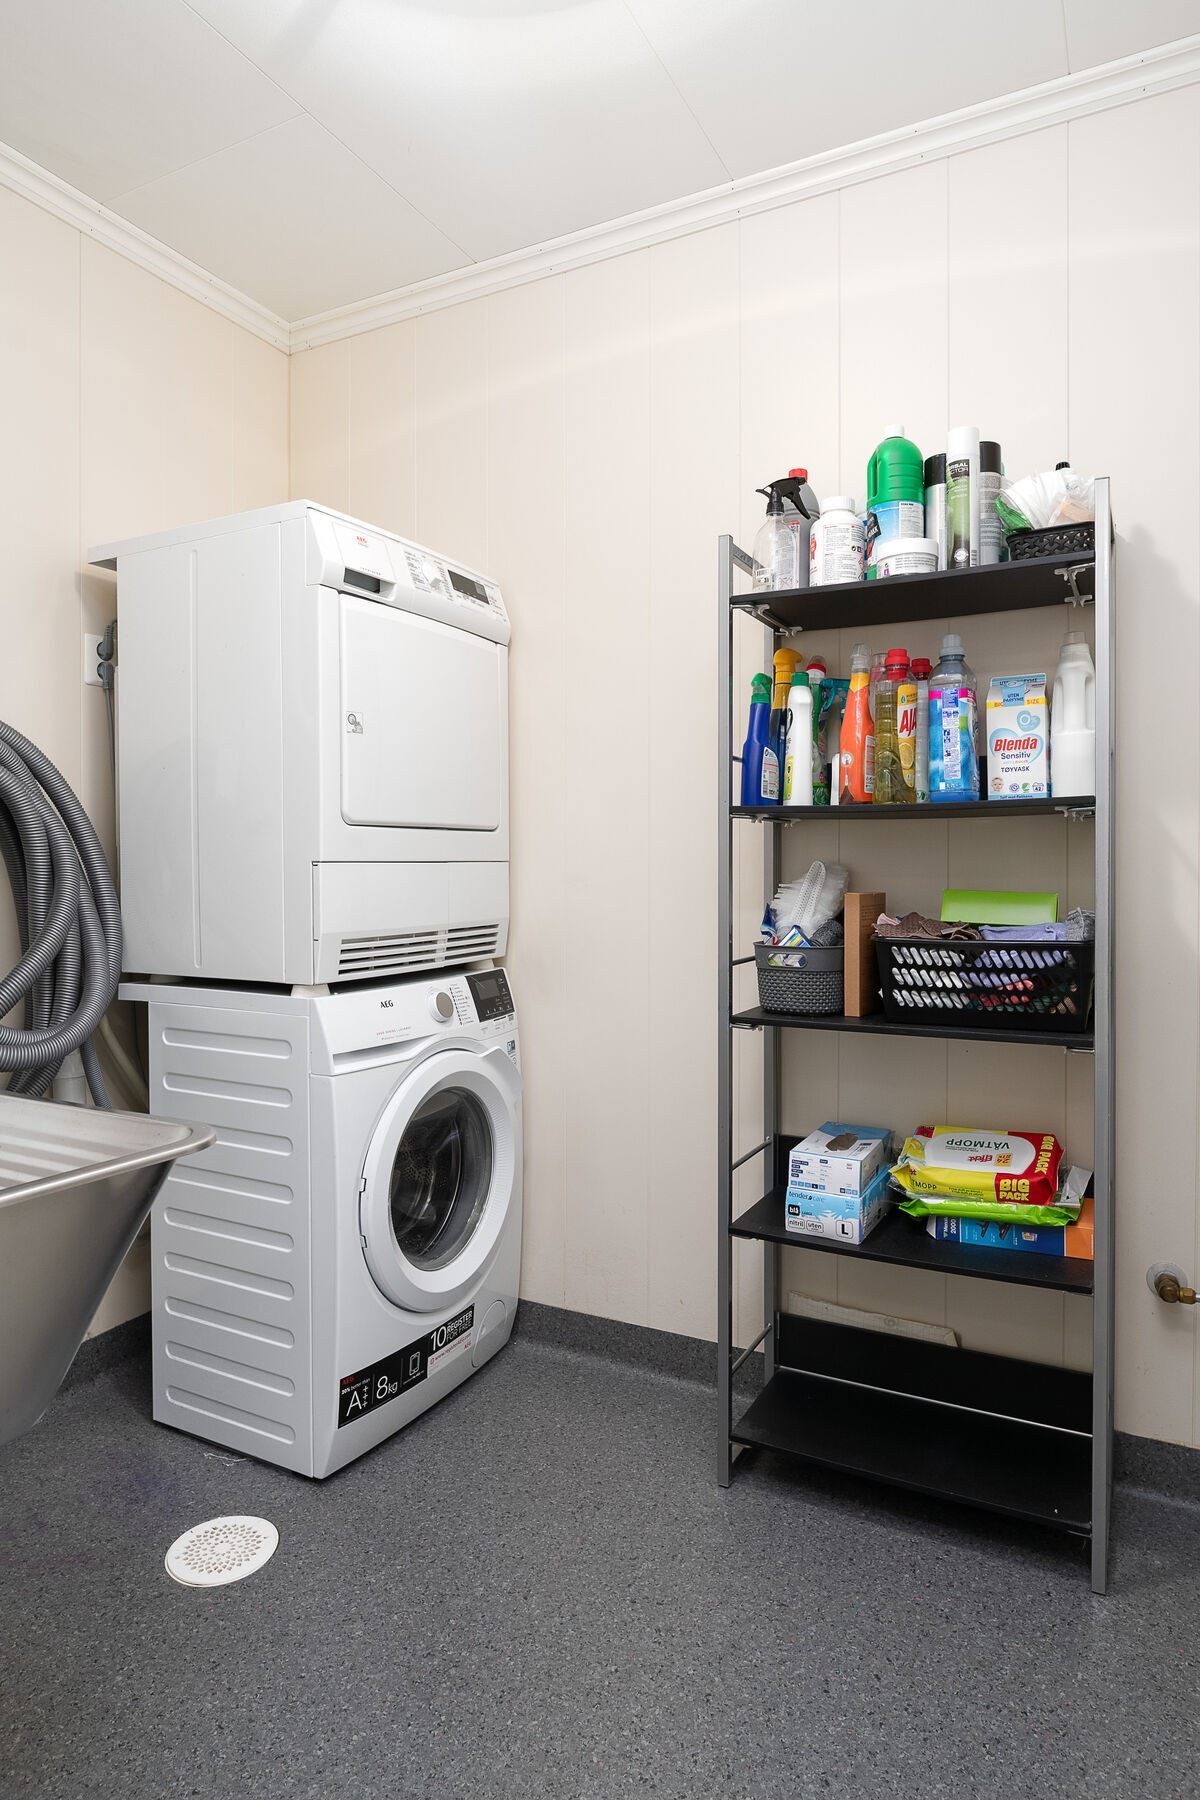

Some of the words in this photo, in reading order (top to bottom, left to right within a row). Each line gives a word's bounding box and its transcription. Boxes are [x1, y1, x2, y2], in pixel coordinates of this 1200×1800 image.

[994, 736, 1038, 752] Blenda
[1000, 751, 1031, 760] Sensitiv
[1001, 765, 1030, 773] TØYVASK
[380, 1000, 394, 1008] AEG
[946, 1138, 1010, 1150] VÅTMOPP
[1040, 1135, 1055, 1150] BIG
[968, 1154, 993, 1163] Effekt
[1034, 1151, 1052, 1175] PACK
[999, 1178, 1030, 1193] BIG
[788, 1191, 808, 1200] tender
[999, 1191, 1029, 1201] PACK
[789, 1219, 804, 1227] nitril
[841, 1223, 849, 1235] L
[447, 1310, 473, 1332] REGISTER
[447, 1329, 458, 1342] FOR
[459, 1318, 472, 1334] FREE
[430, 1326, 447, 1351] 10
